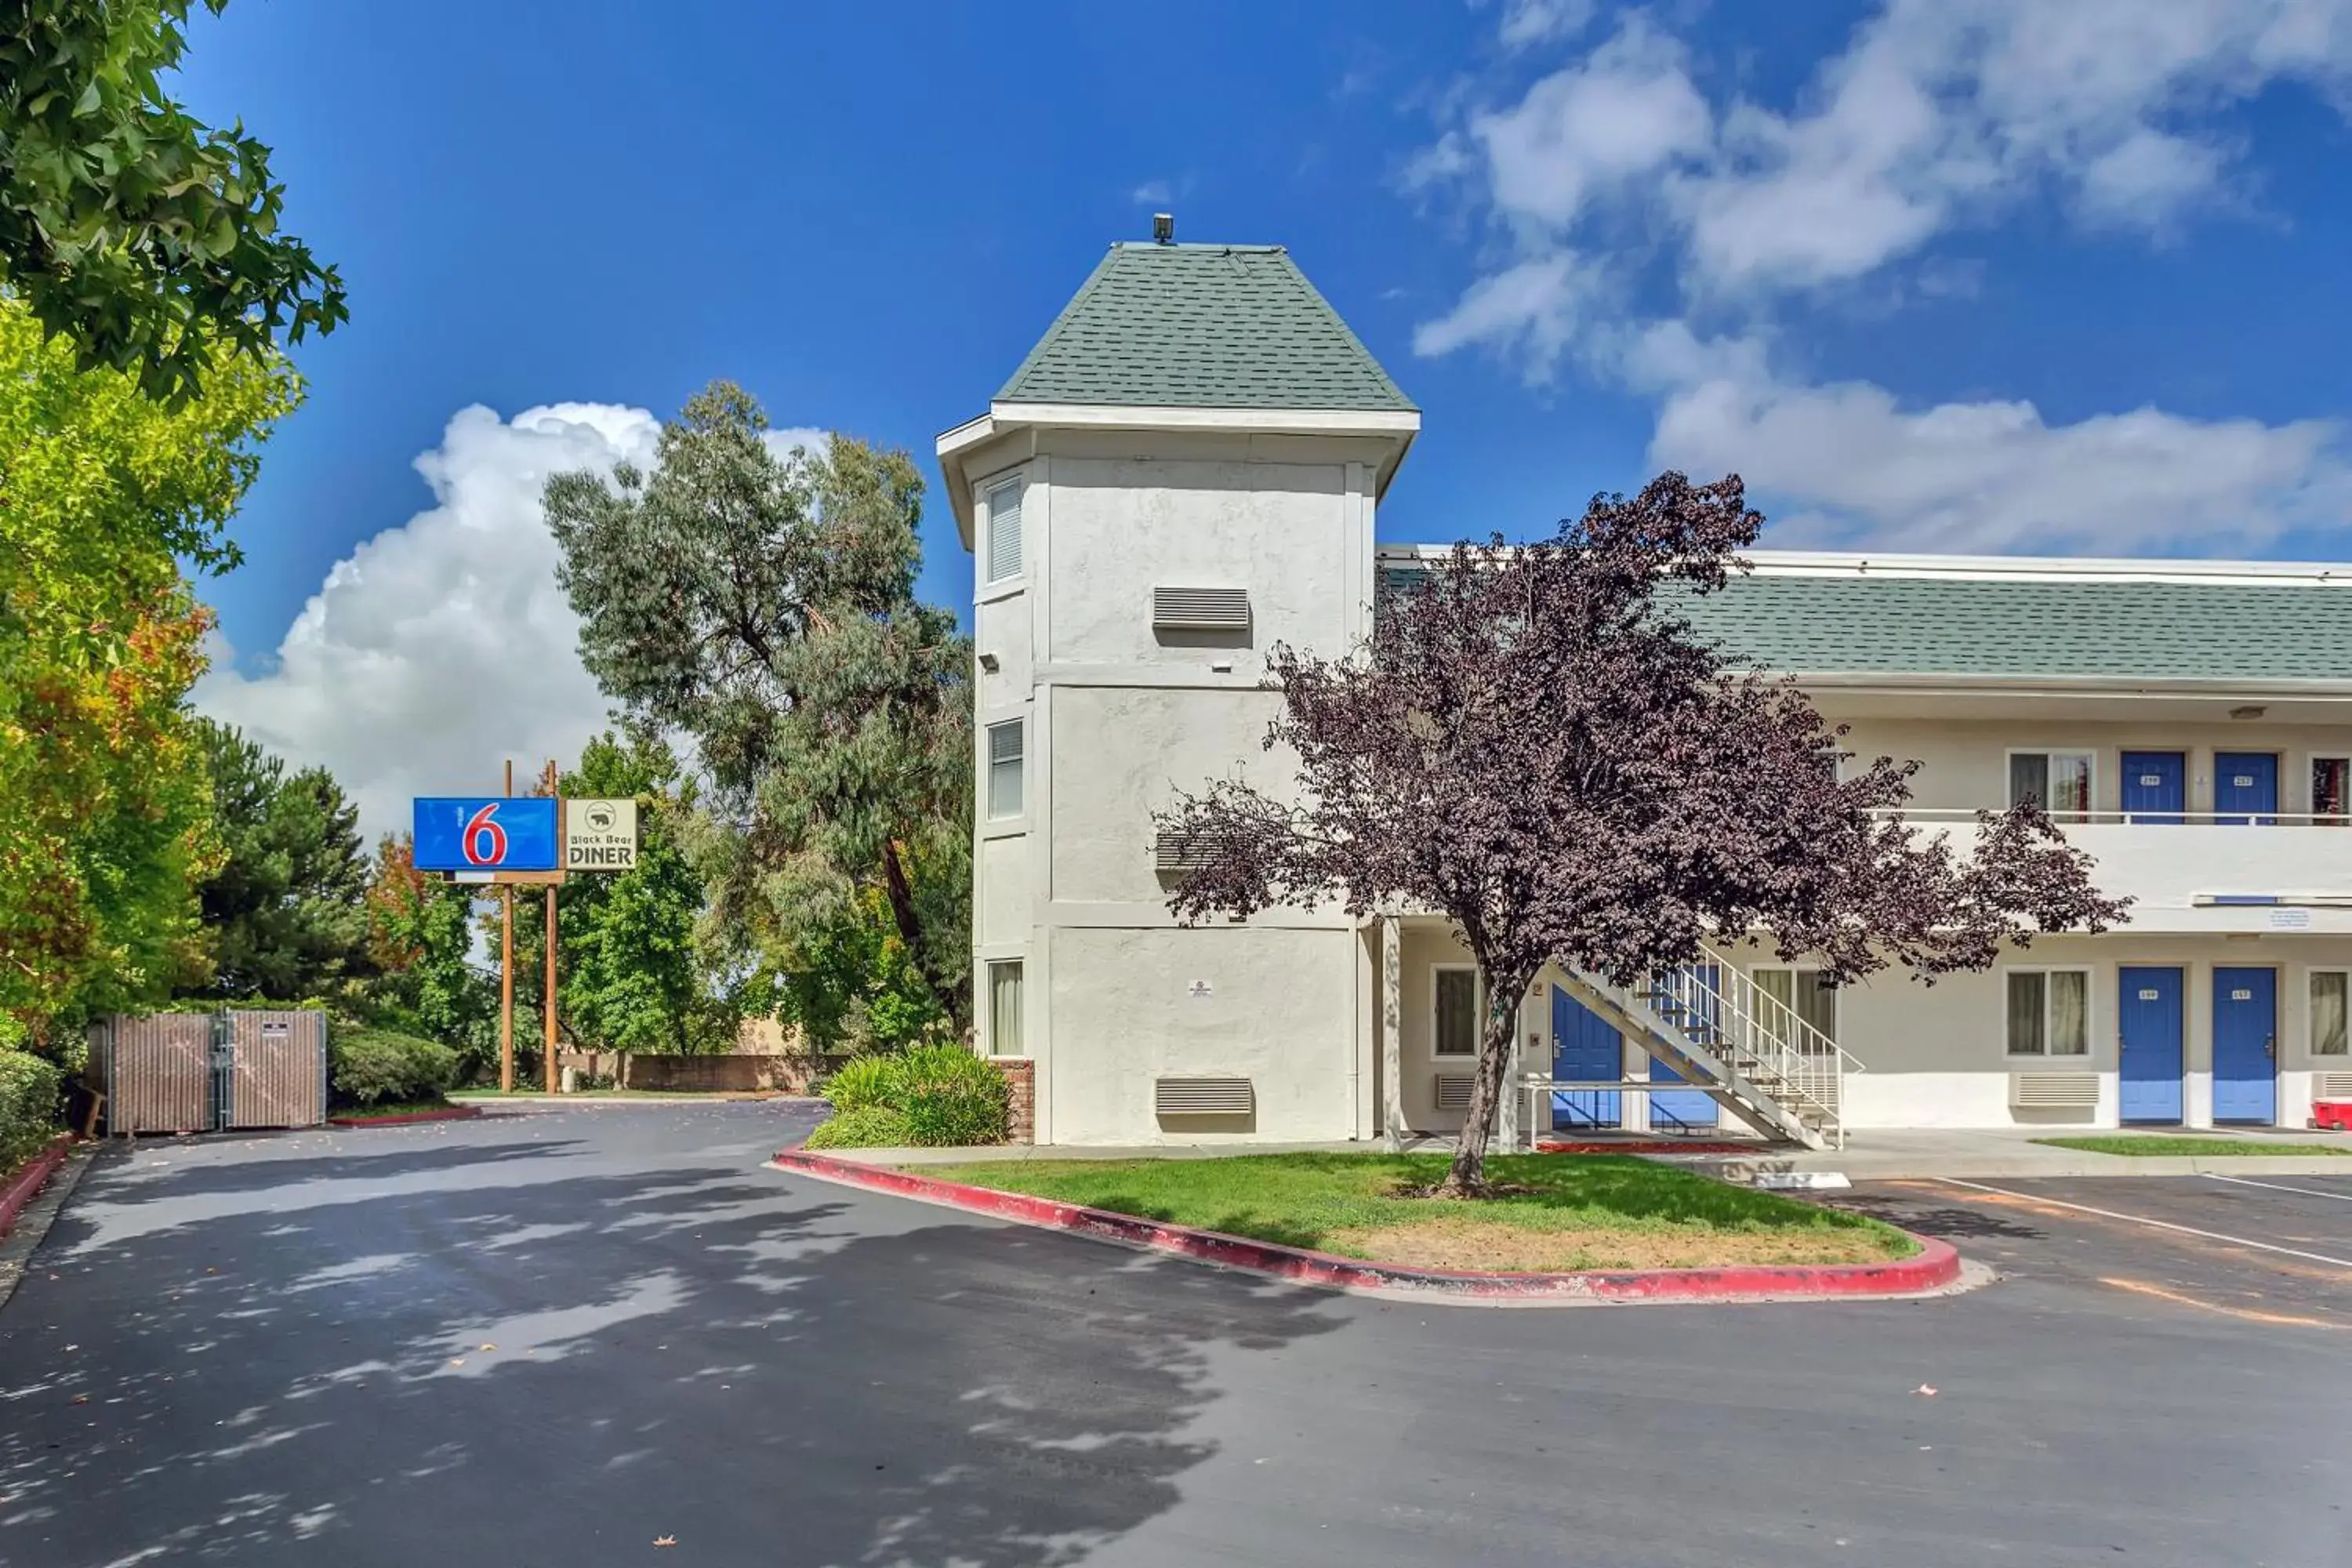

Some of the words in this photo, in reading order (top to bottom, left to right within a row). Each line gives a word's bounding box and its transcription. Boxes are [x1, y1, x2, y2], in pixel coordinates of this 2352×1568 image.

[463, 803, 507, 865] 6
[571, 835, 601, 844] Black
[606, 835, 632, 844] Bear
[570, 848, 632, 865] DINER
